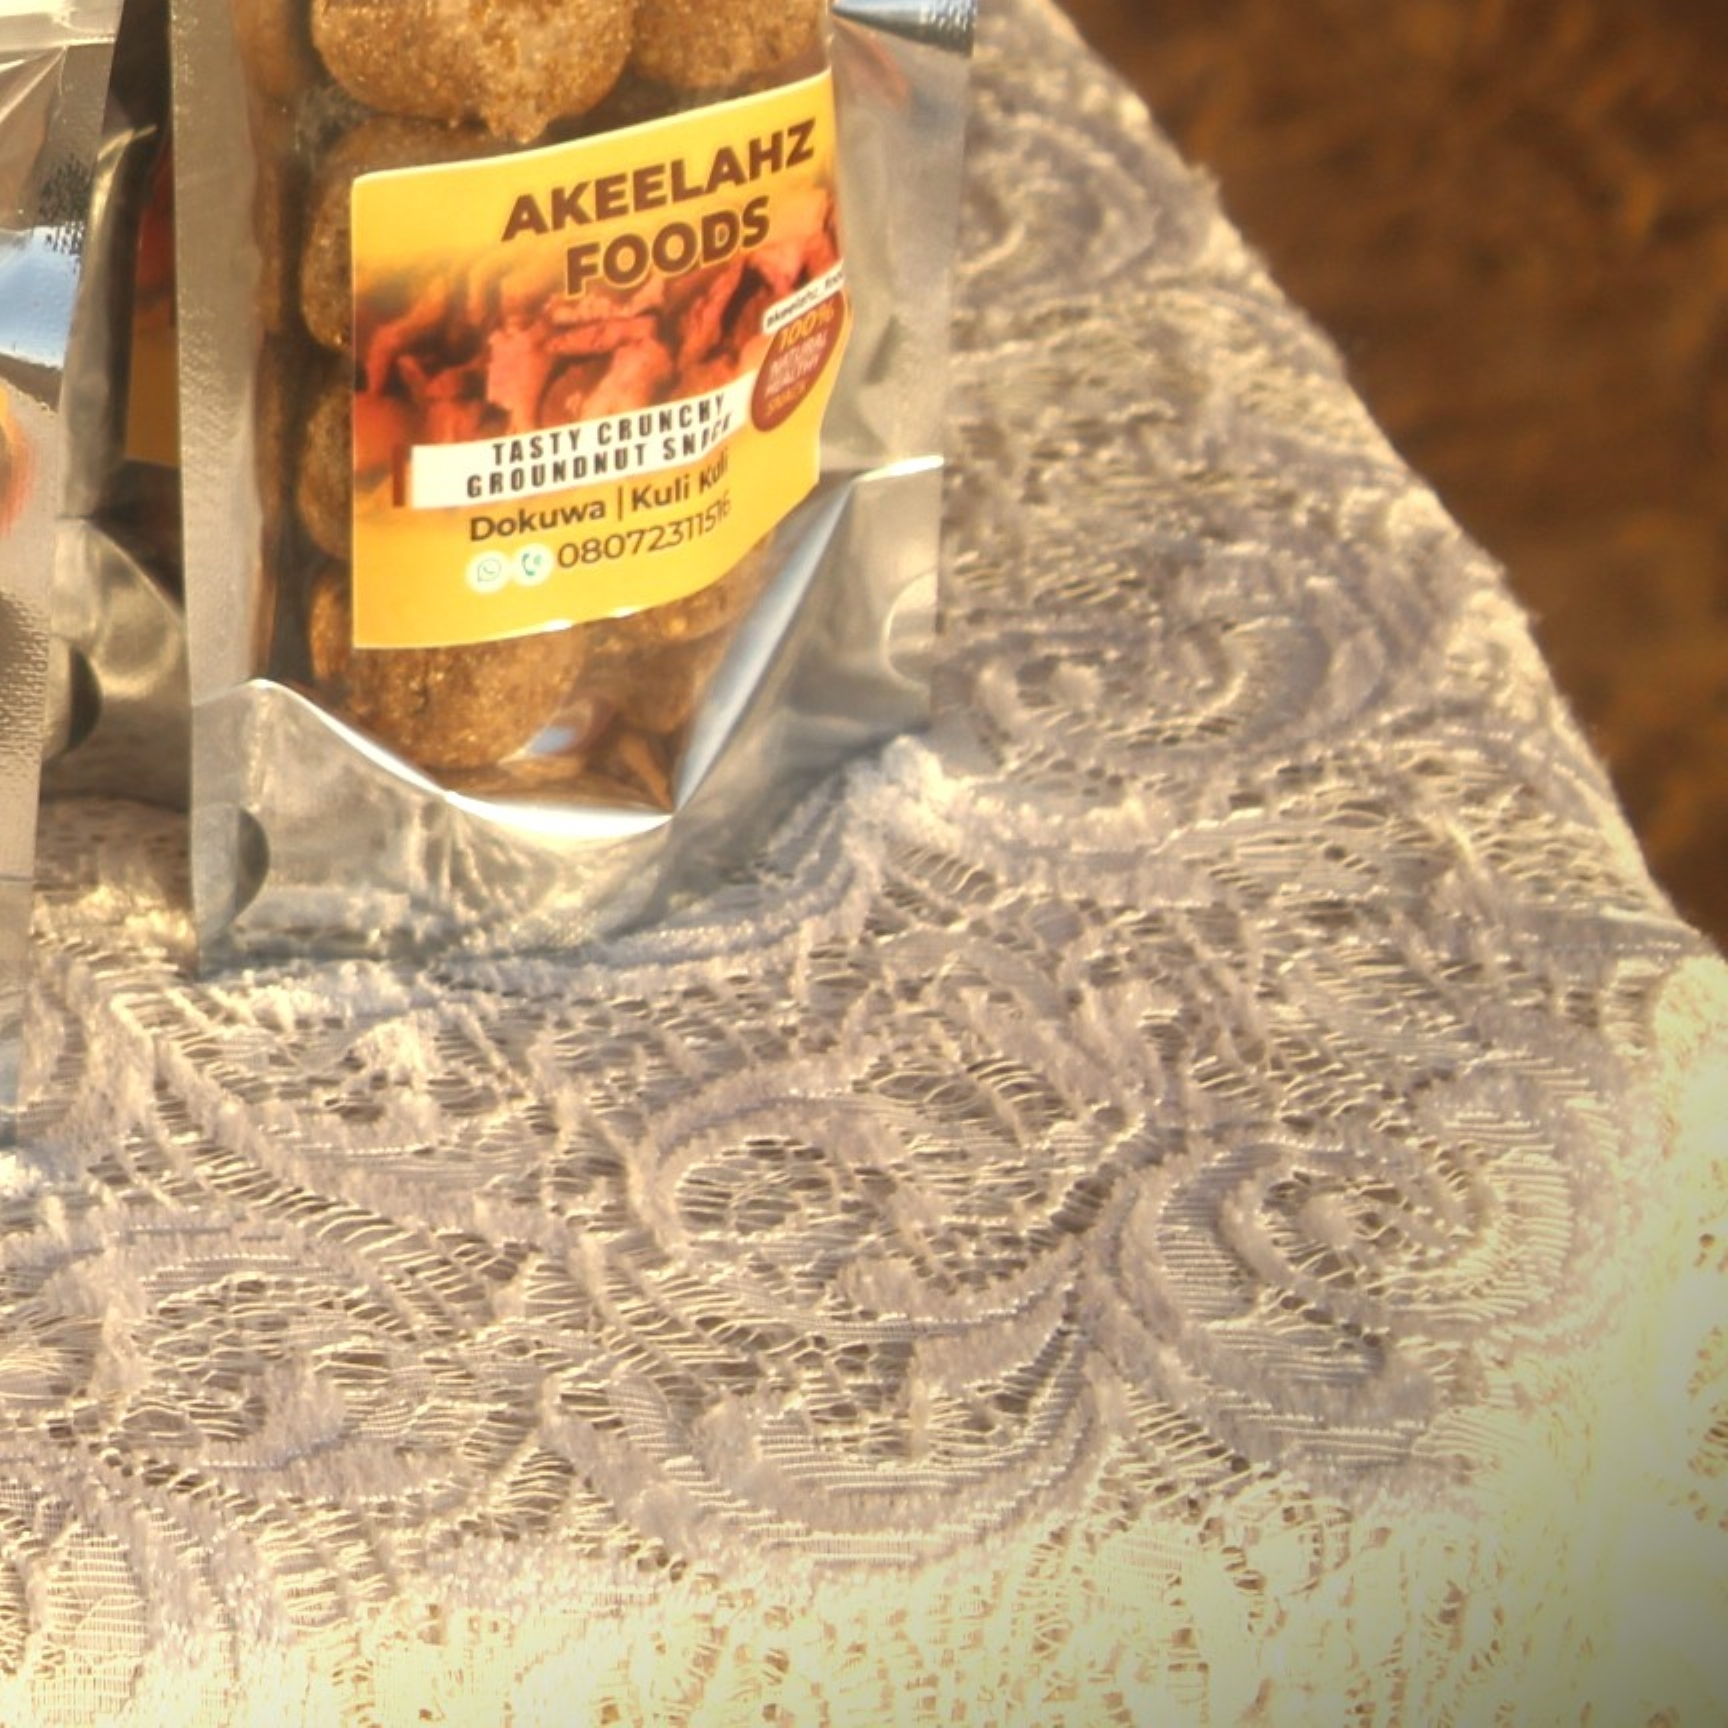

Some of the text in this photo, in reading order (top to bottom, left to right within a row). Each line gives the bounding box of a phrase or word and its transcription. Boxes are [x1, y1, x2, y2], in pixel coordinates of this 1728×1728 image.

[501, 117, 817, 241] AKEELAHZ
[564, 196, 771, 297] FOODS
[466, 443, 647, 499] GROUNDNUT
[492, 394, 725, 467] TASTY CRUNCHY
[469, 500, 607, 542] Dokuwa
[631, 474, 691, 512] Kuli
[698, 448, 730, 495] Kuli
[557, 489, 733, 569] 08072311516
